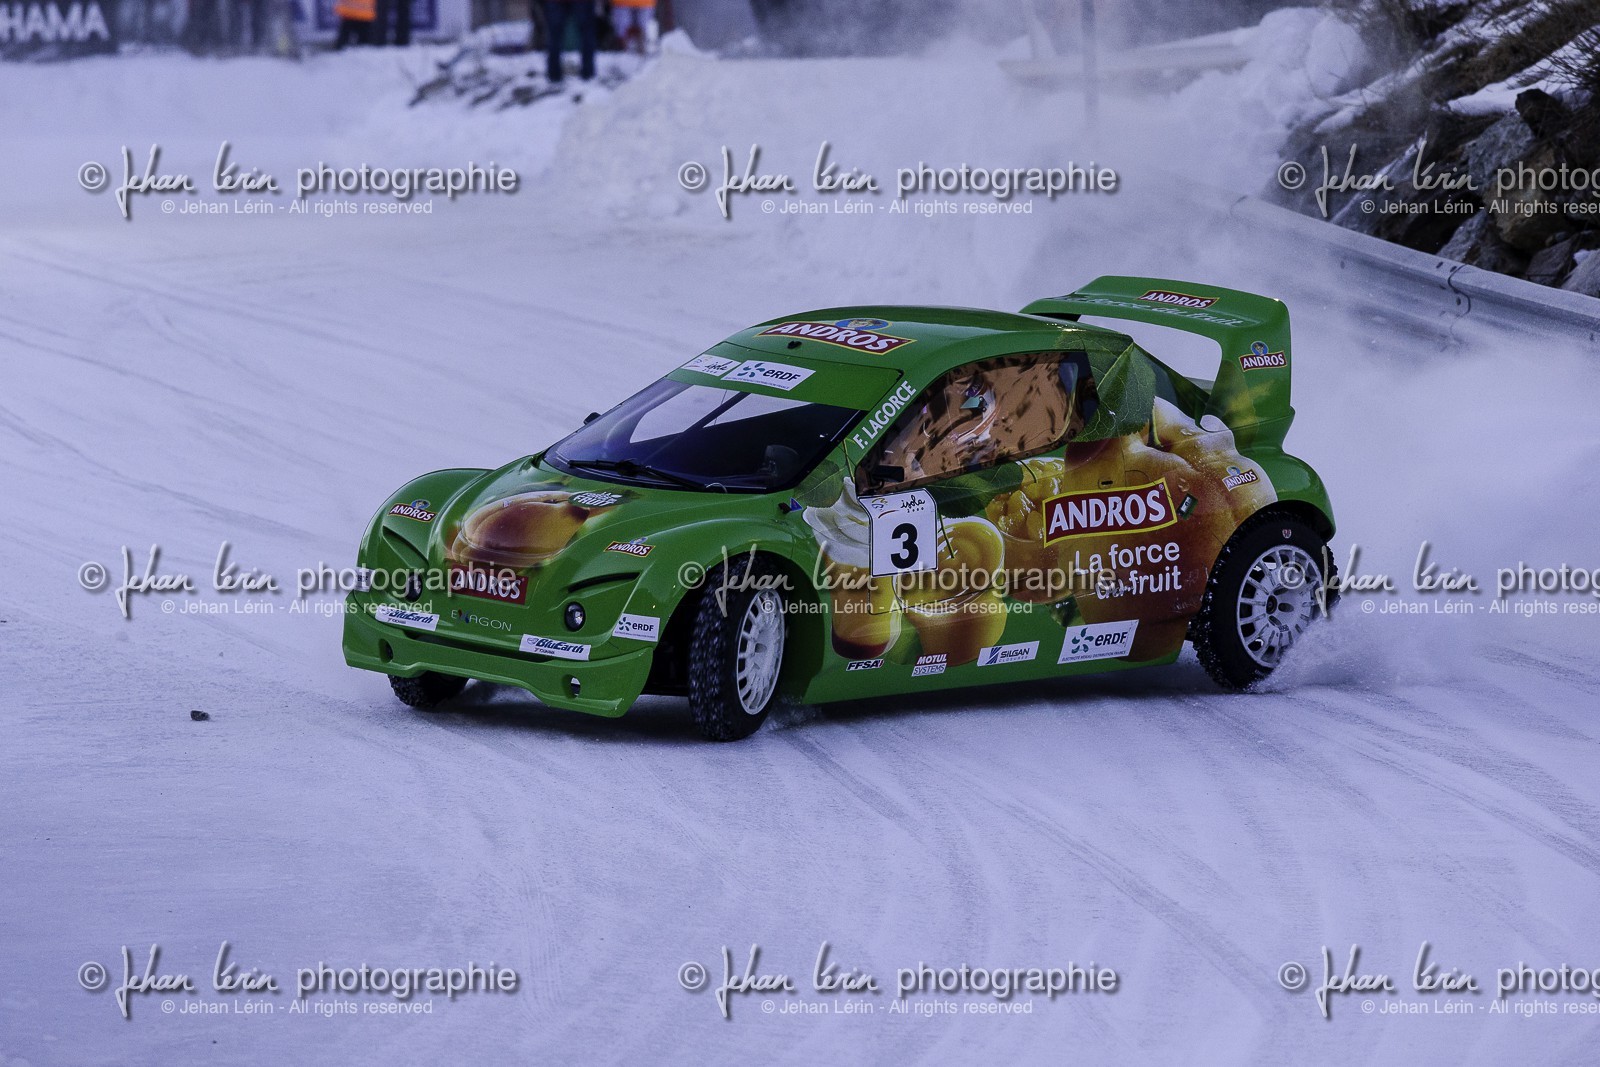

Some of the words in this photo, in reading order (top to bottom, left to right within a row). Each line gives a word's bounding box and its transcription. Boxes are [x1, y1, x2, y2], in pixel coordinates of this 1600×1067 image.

[1141, 292, 1212, 308] ANDROS
[768, 323, 900, 351] ANDROS
[1242, 353, 1285, 368] ANDROS
[852, 434, 869, 450] F.
[861, 381, 917, 439] LAGORCE
[1225, 471, 1257, 489] ANDROS
[389, 504, 436, 521] ANDROS
[1048, 488, 1167, 535] ANDROS
[608, 542, 651, 556] ANDROS
[890, 522, 919, 569] 3
[1075, 550, 1104, 575] La
[1108, 542, 1180, 570] force
[453, 570, 521, 599] ANDROS
[1129, 565, 1182, 595] fruit
[389, 610, 434, 624] BluEarth
[536, 638, 584, 653] BluEarth
[1000, 648, 1031, 658] SILGAN
[847, 660, 880, 671] FFSA
[916, 654, 947, 665] MOTUL
[913, 664, 946, 675] SYSTEMS
